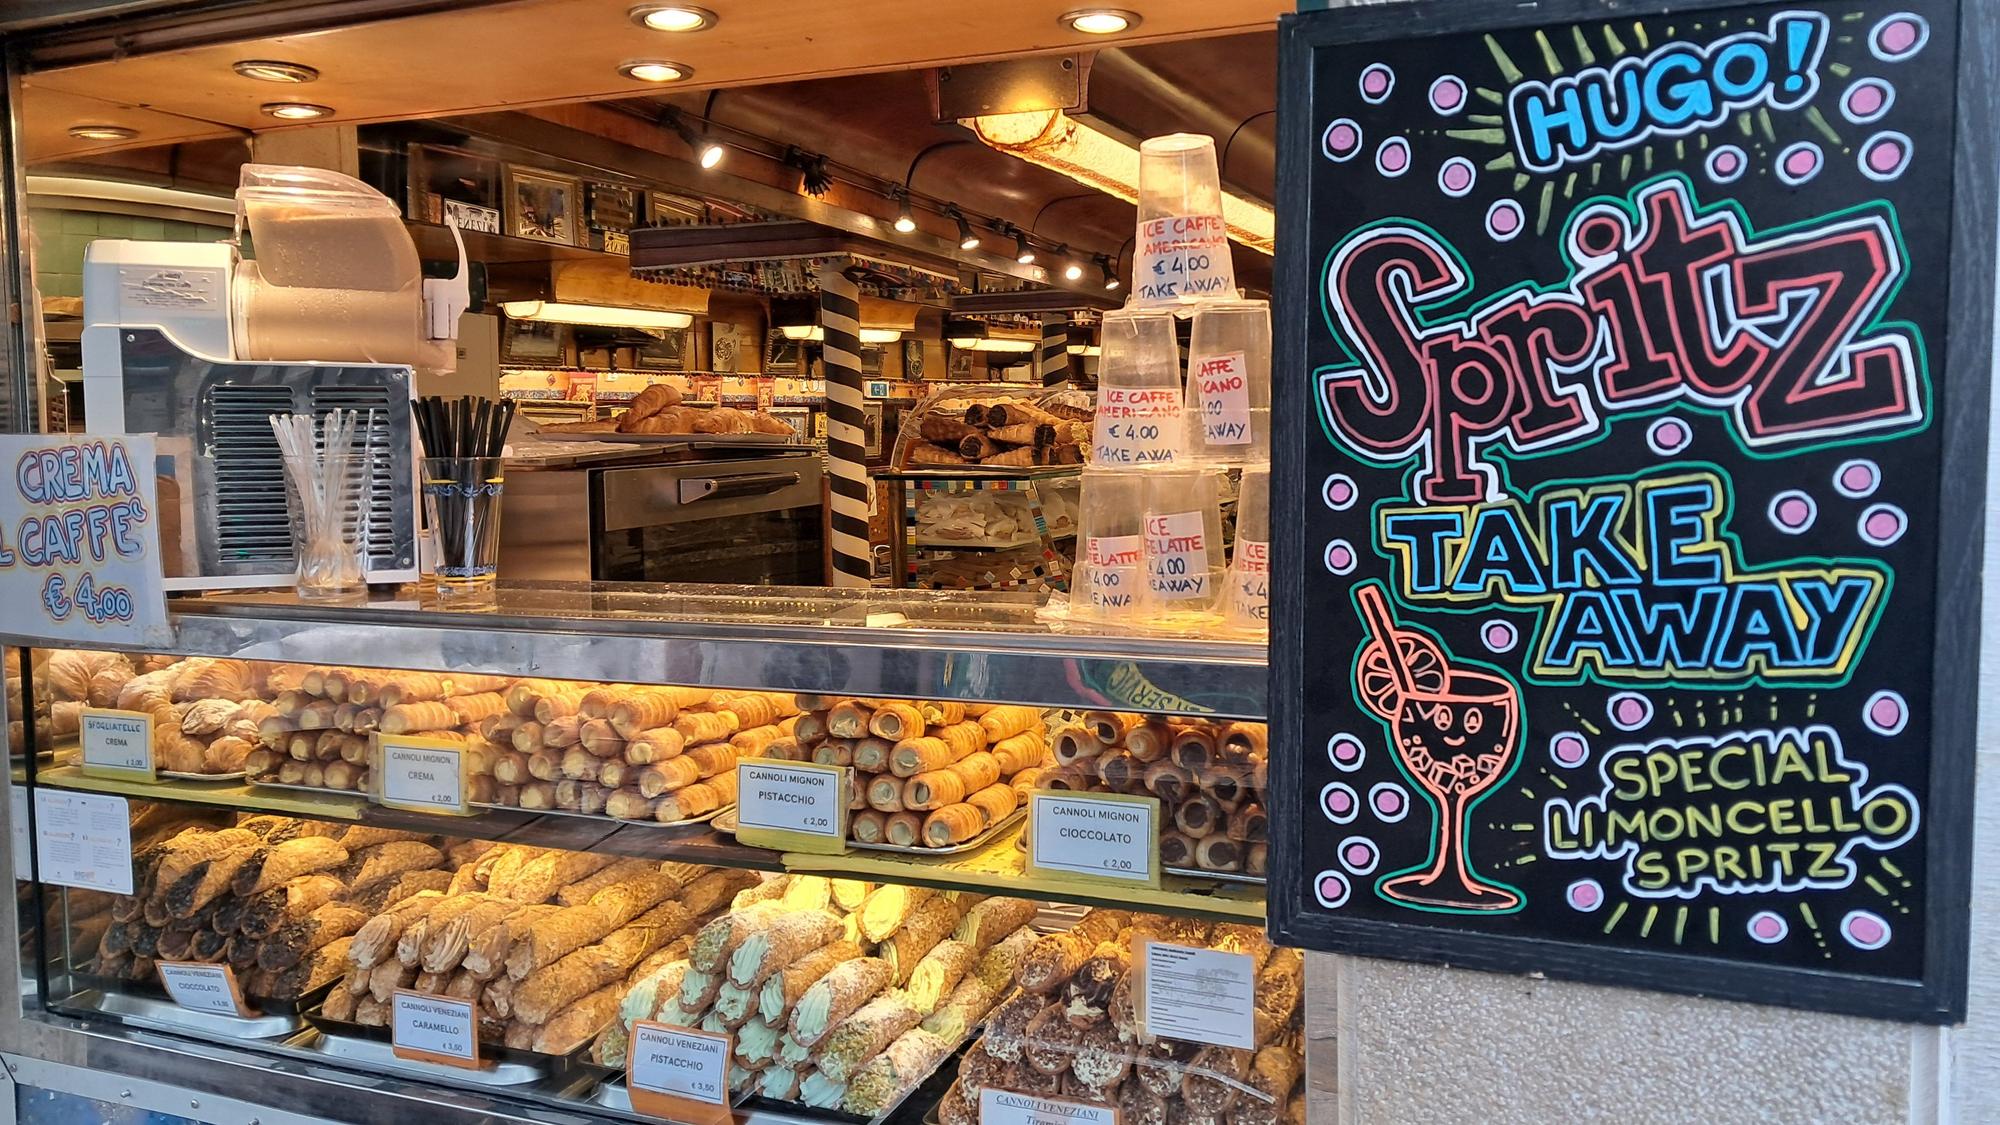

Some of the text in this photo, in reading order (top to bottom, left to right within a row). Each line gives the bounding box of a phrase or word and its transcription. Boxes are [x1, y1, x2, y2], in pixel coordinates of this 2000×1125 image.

[1525, 20, 1814, 161] HUGO!
[1143, 221, 1165, 238] ICE
[1139, 276, 1230, 299] TAKE AWAY
[1322, 184, 1916, 505] Spritz
[1106, 389, 1124, 403] ICE
[1125, 424, 1159, 441] 4.00
[1096, 446, 1131, 462] TAKE
[17, 441, 136, 504] CREMA
[1382, 480, 1727, 594] TAKE
[42, 571, 135, 624] € 4,00
[1542, 576, 1876, 672] AWAY
[87, 720, 141, 733] SFOGLIATELLE
[105, 737, 129, 747] CREMA
[392, 752, 452, 765] CANNOLI MIGNON
[407, 771, 435, 782] CREMA
[749, 771, 826, 787] CANNOLI MIGNON
[1613, 739, 1851, 801] SPECIAL
[758, 790, 816, 806] PISTACCHIO
[810, 817, 829, 827] 2,00
[1052, 806, 1140, 824] CANNOLI MIGNON
[1552, 796, 1908, 849] LIMONCELLO
[1059, 827, 1132, 845] CIOCCOLATO
[1111, 859, 1132, 871] 2,00
[1636, 843, 1847, 889] SPRITZ
[178, 982, 220, 993] CIOCCOLATO
[401, 1001, 469, 1020] CANNOLI VENEZIANI
[412, 1020, 460, 1036] CARAMELLO
[640, 1032, 719, 1055] CANNOLI VENEZIANI
[650, 1053, 704, 1072] PISTACCHIO
[697, 1082, 715, 1093] 3,50
[996, 1094, 1100, 1121] CANNOLI VENEZIANI
